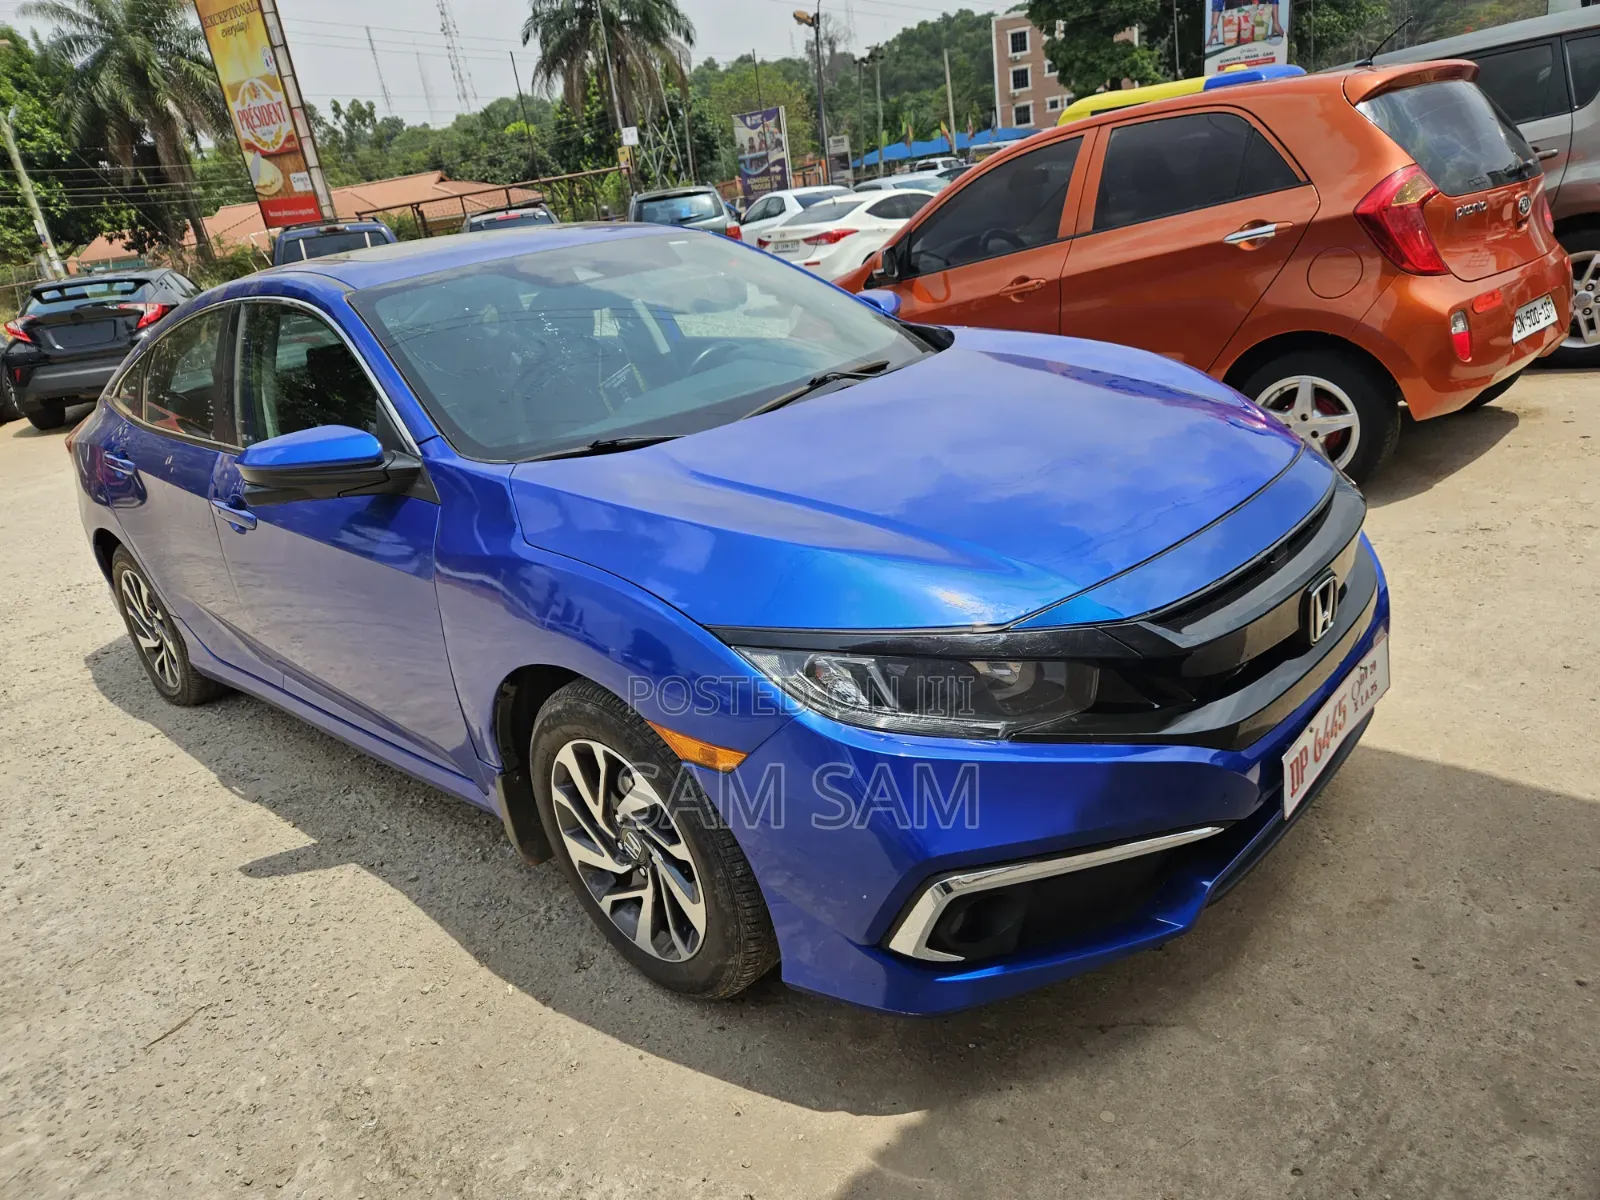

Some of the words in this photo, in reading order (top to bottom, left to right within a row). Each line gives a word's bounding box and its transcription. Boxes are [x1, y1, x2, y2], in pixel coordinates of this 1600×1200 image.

[203, 0, 257, 28] EXCEPTIONAL
[237, 101, 286, 133] PRÉSIDENT
[1289, 745, 1309, 798] DP
[1314, 693, 1348, 764] 6445
